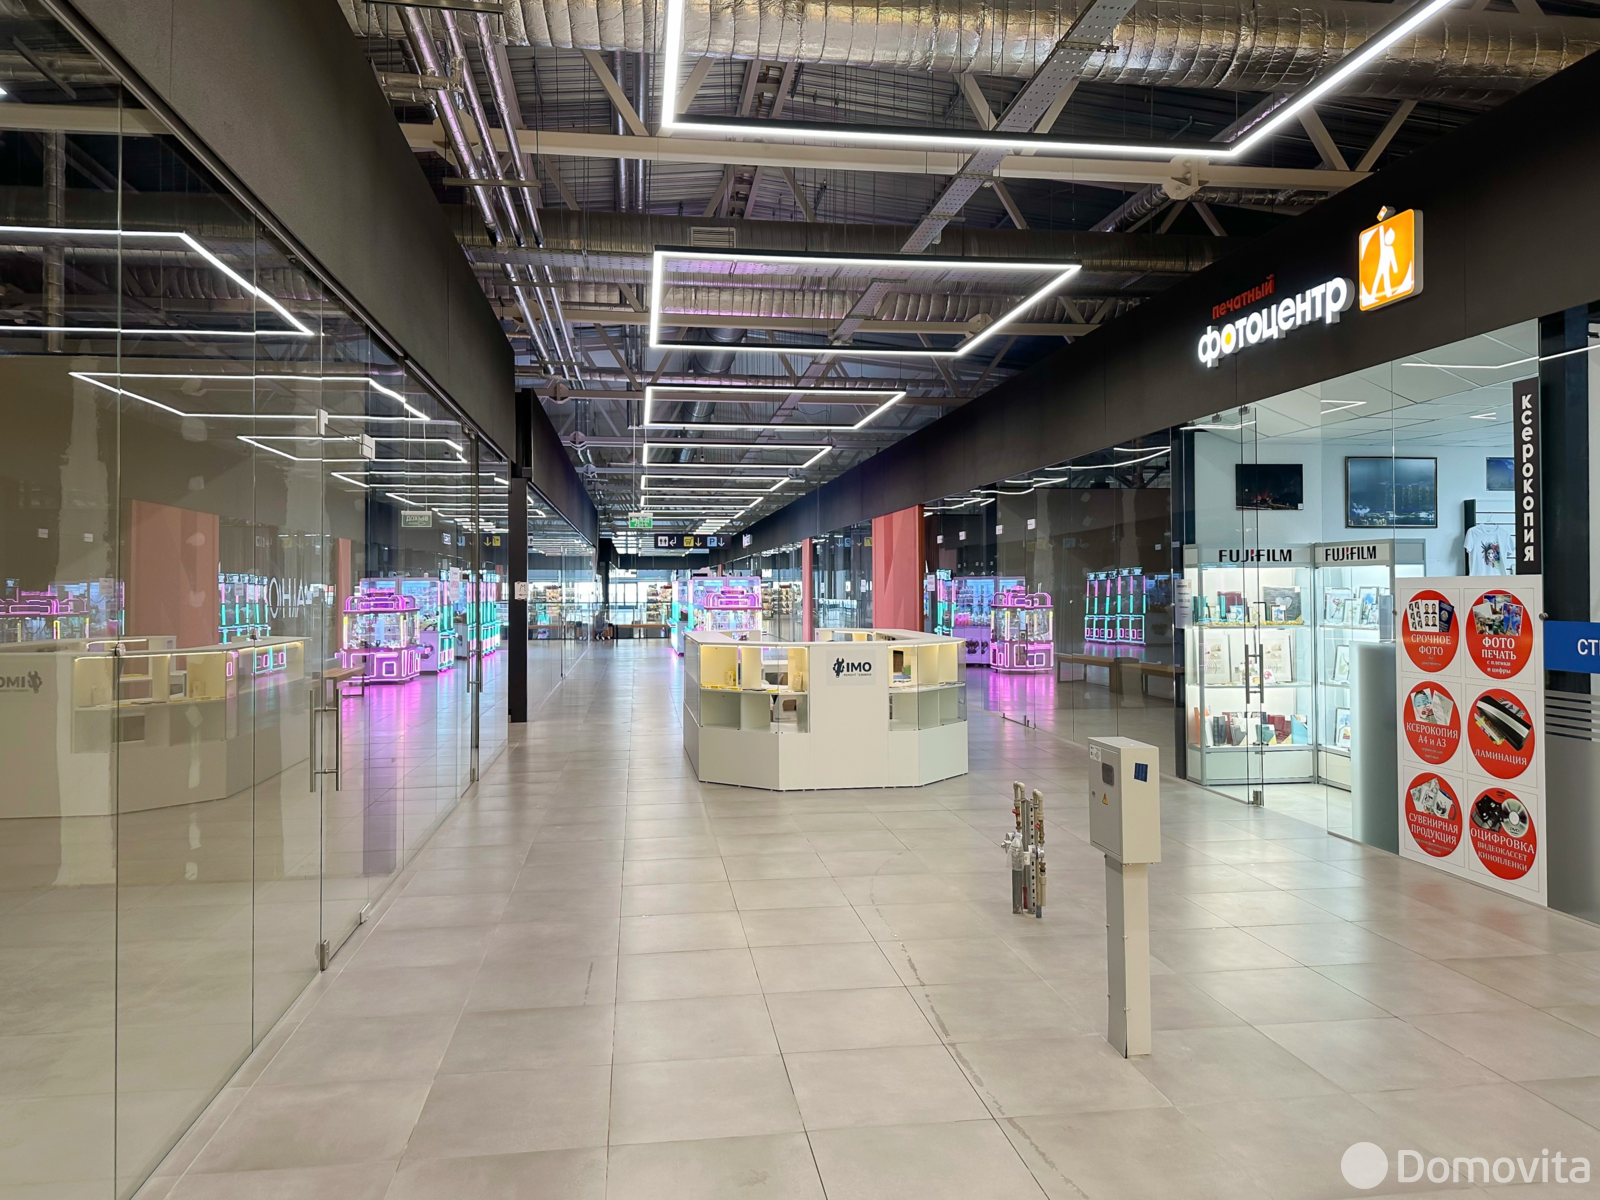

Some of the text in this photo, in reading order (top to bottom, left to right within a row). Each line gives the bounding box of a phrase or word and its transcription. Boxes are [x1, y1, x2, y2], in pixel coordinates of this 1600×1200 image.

[1212, 274, 1275, 320] печатный
[1198, 277, 1349, 367] фотоцентр
[1521, 393, 1535, 562] ксерокопия
[1218, 549, 1293, 563] FUJIFILM
[1325, 545, 1377, 562] FUJIFILM
[1411, 633, 1452, 645] СРОЧНОЕ
[1482, 636, 1515, 649] ФОТО
[1577, 638, 1600, 656] СТ
[1418, 645, 1444, 656] ФОТО
[1481, 649, 1517, 660] ПЕЧАТЬ
[846, 661, 872, 673] IMO
[1491, 667, 1511, 675] цифры
[1406, 722, 1458, 739] КСЕРОКОПИЯ
[1418, 734, 1447, 748] А4 и А3
[1474, 748, 1527, 766] ЛАМИНАЦИЯ
[1409, 812, 1458, 834] СУВЕНИРНАЯ
[1411, 824, 1457, 845] ПРОДУКЦИЯ
[1470, 828, 1535, 854] ОЦИФРОВКА
[1477, 841, 1528, 862] ВИДЕОКАССЕТ
[1478, 851, 1528, 872] КИНОПЛЕНКИ
